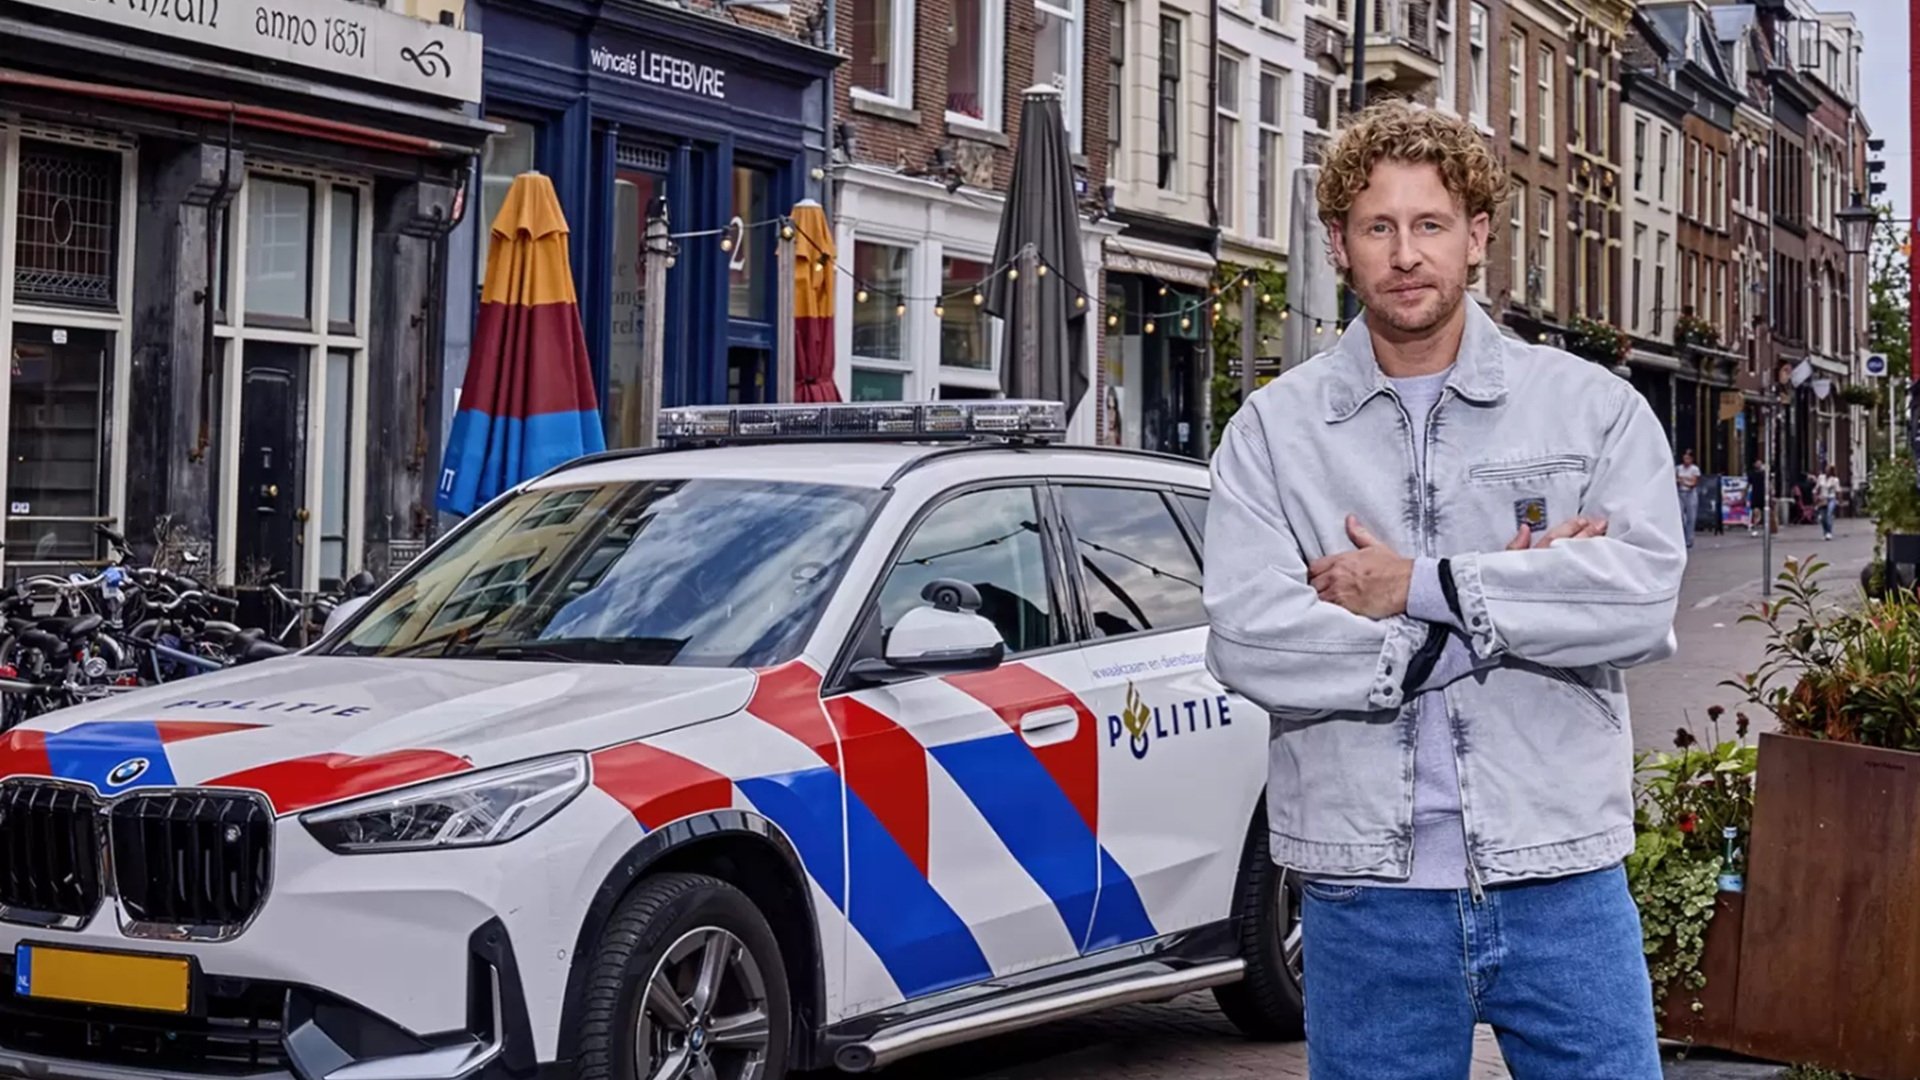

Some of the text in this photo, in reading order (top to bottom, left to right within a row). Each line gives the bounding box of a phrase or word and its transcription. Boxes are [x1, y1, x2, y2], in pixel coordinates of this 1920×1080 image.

[255, 6, 317, 47] anno
[324, 16, 366, 59] 1851
[590, 46, 725, 98] wijncafé LEFEBVRE
[729, 215, 745, 271] 2
[162, 700, 371, 717] POLITIE
[1107, 694, 1233, 760] POLITIE
